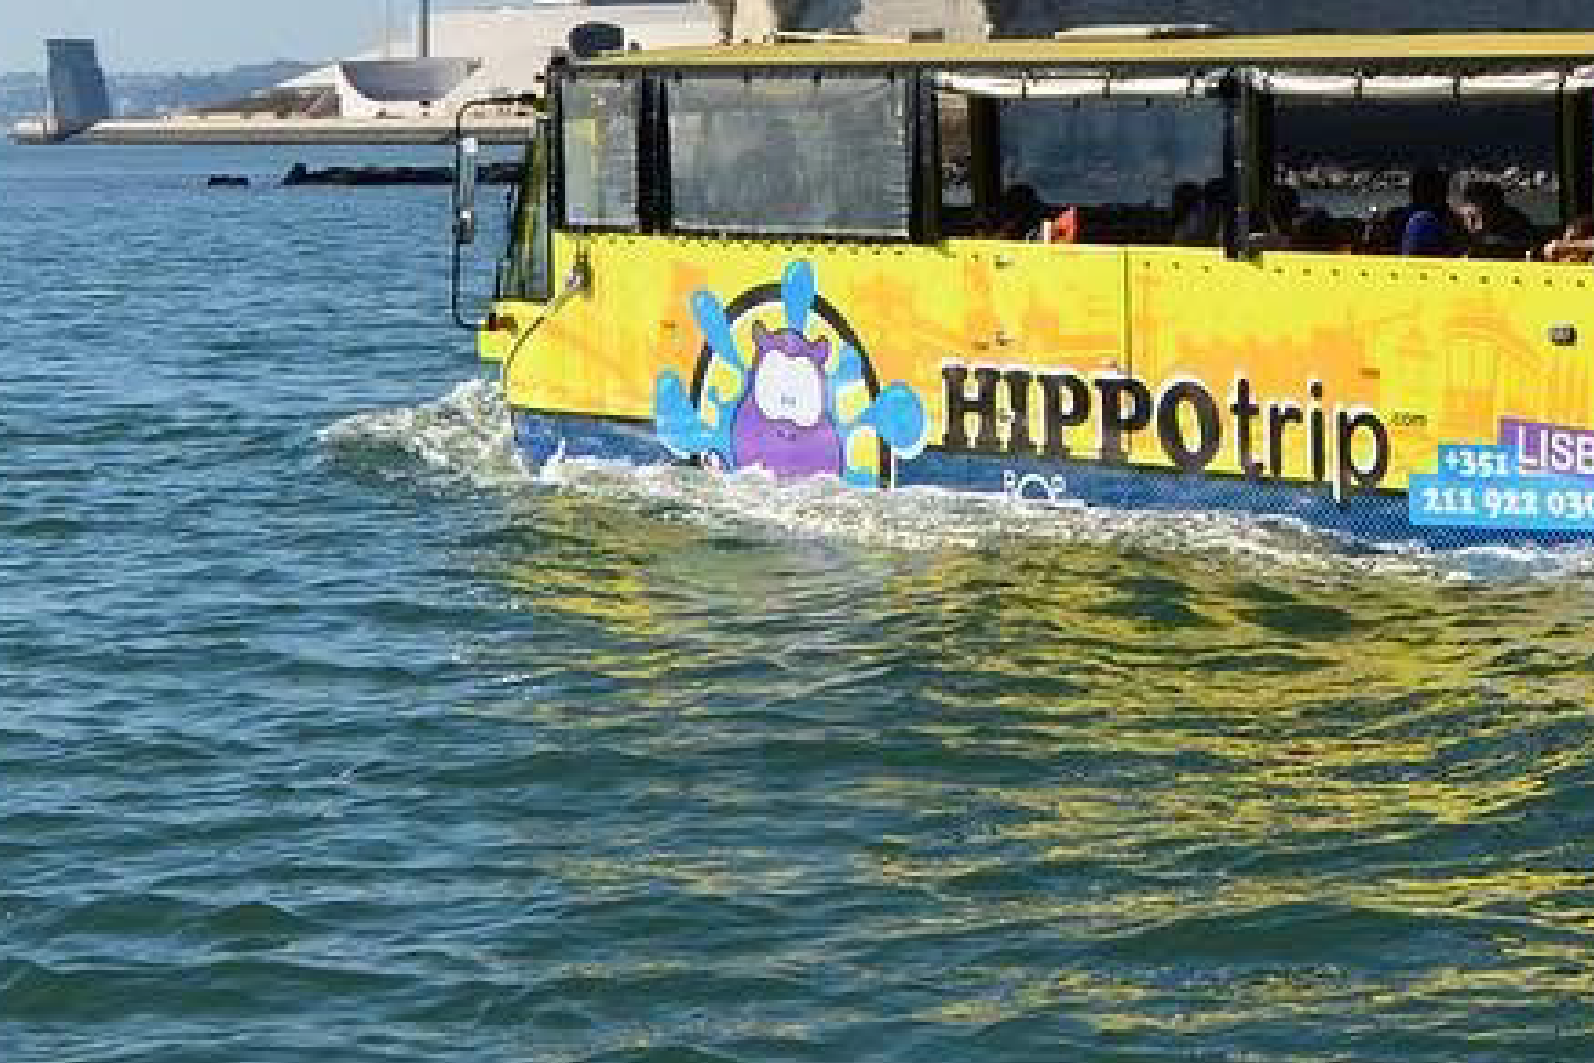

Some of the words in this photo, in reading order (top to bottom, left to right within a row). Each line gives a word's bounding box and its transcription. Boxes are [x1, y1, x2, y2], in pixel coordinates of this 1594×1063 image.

[941, 365, 1390, 505] HIPPOtrip
[1445, 449, 1511, 479] +351
[1423, 487, 1476, 515] 211
